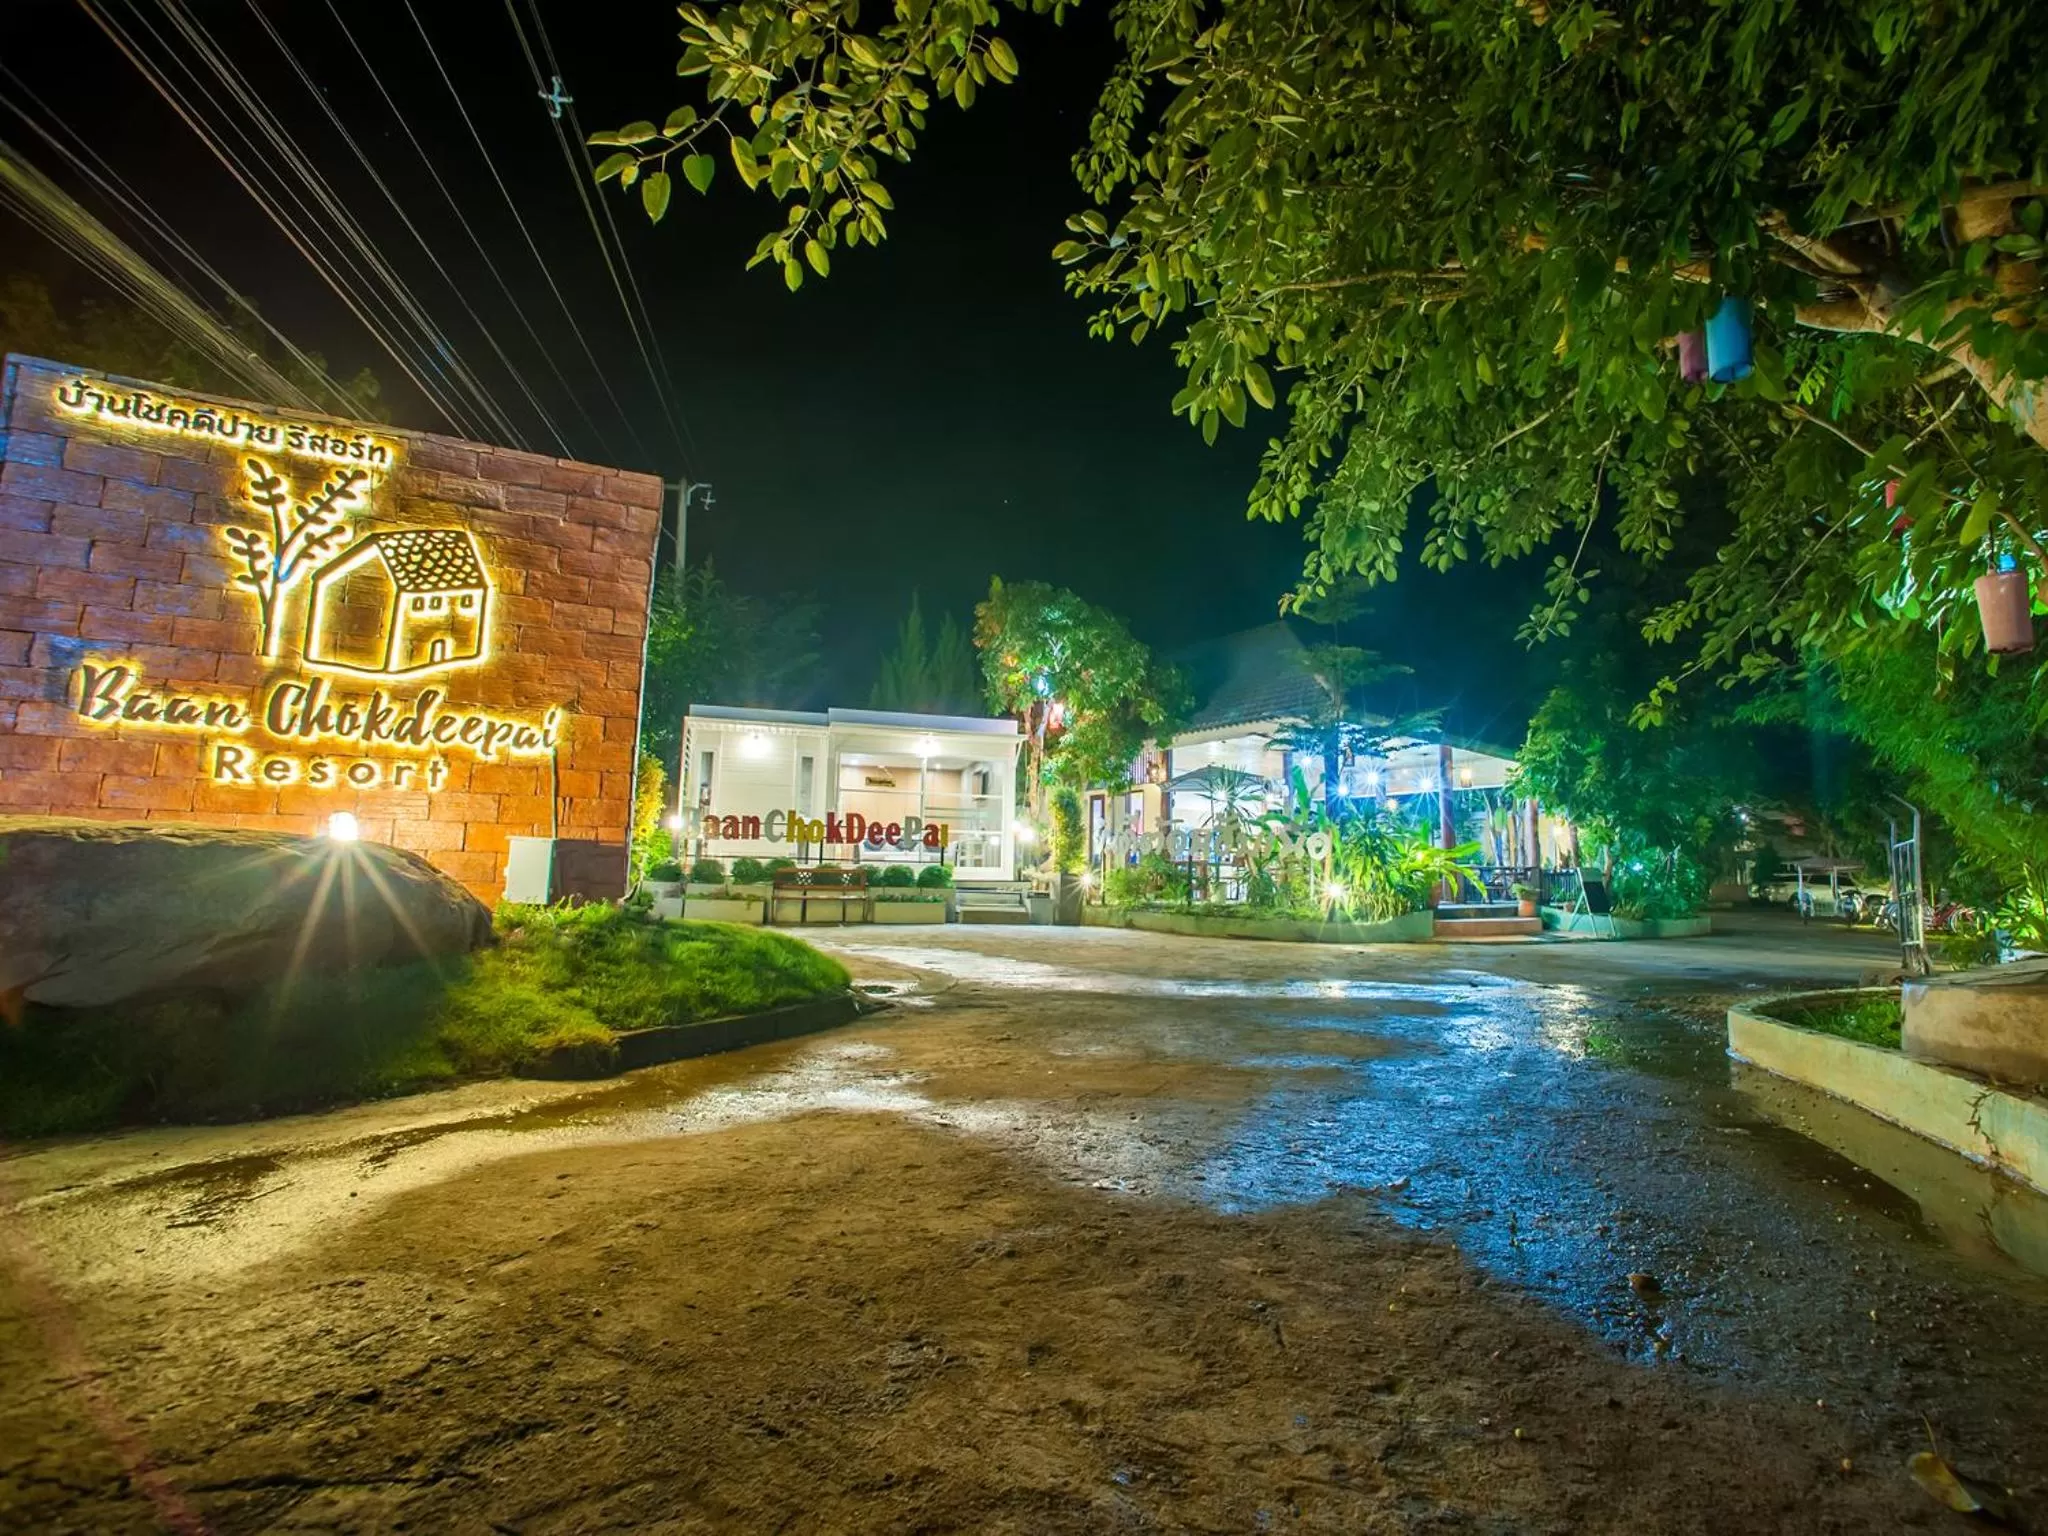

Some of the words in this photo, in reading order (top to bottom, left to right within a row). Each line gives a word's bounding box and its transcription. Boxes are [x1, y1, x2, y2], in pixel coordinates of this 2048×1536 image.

[58, 379, 278, 444] บ้านโชคดีปาย
[287, 424, 387, 464] รีสอร์ท
[79, 664, 247, 728] Baan
[267, 676, 556, 756] Chokdeepai
[213, 745, 447, 787] Resort
